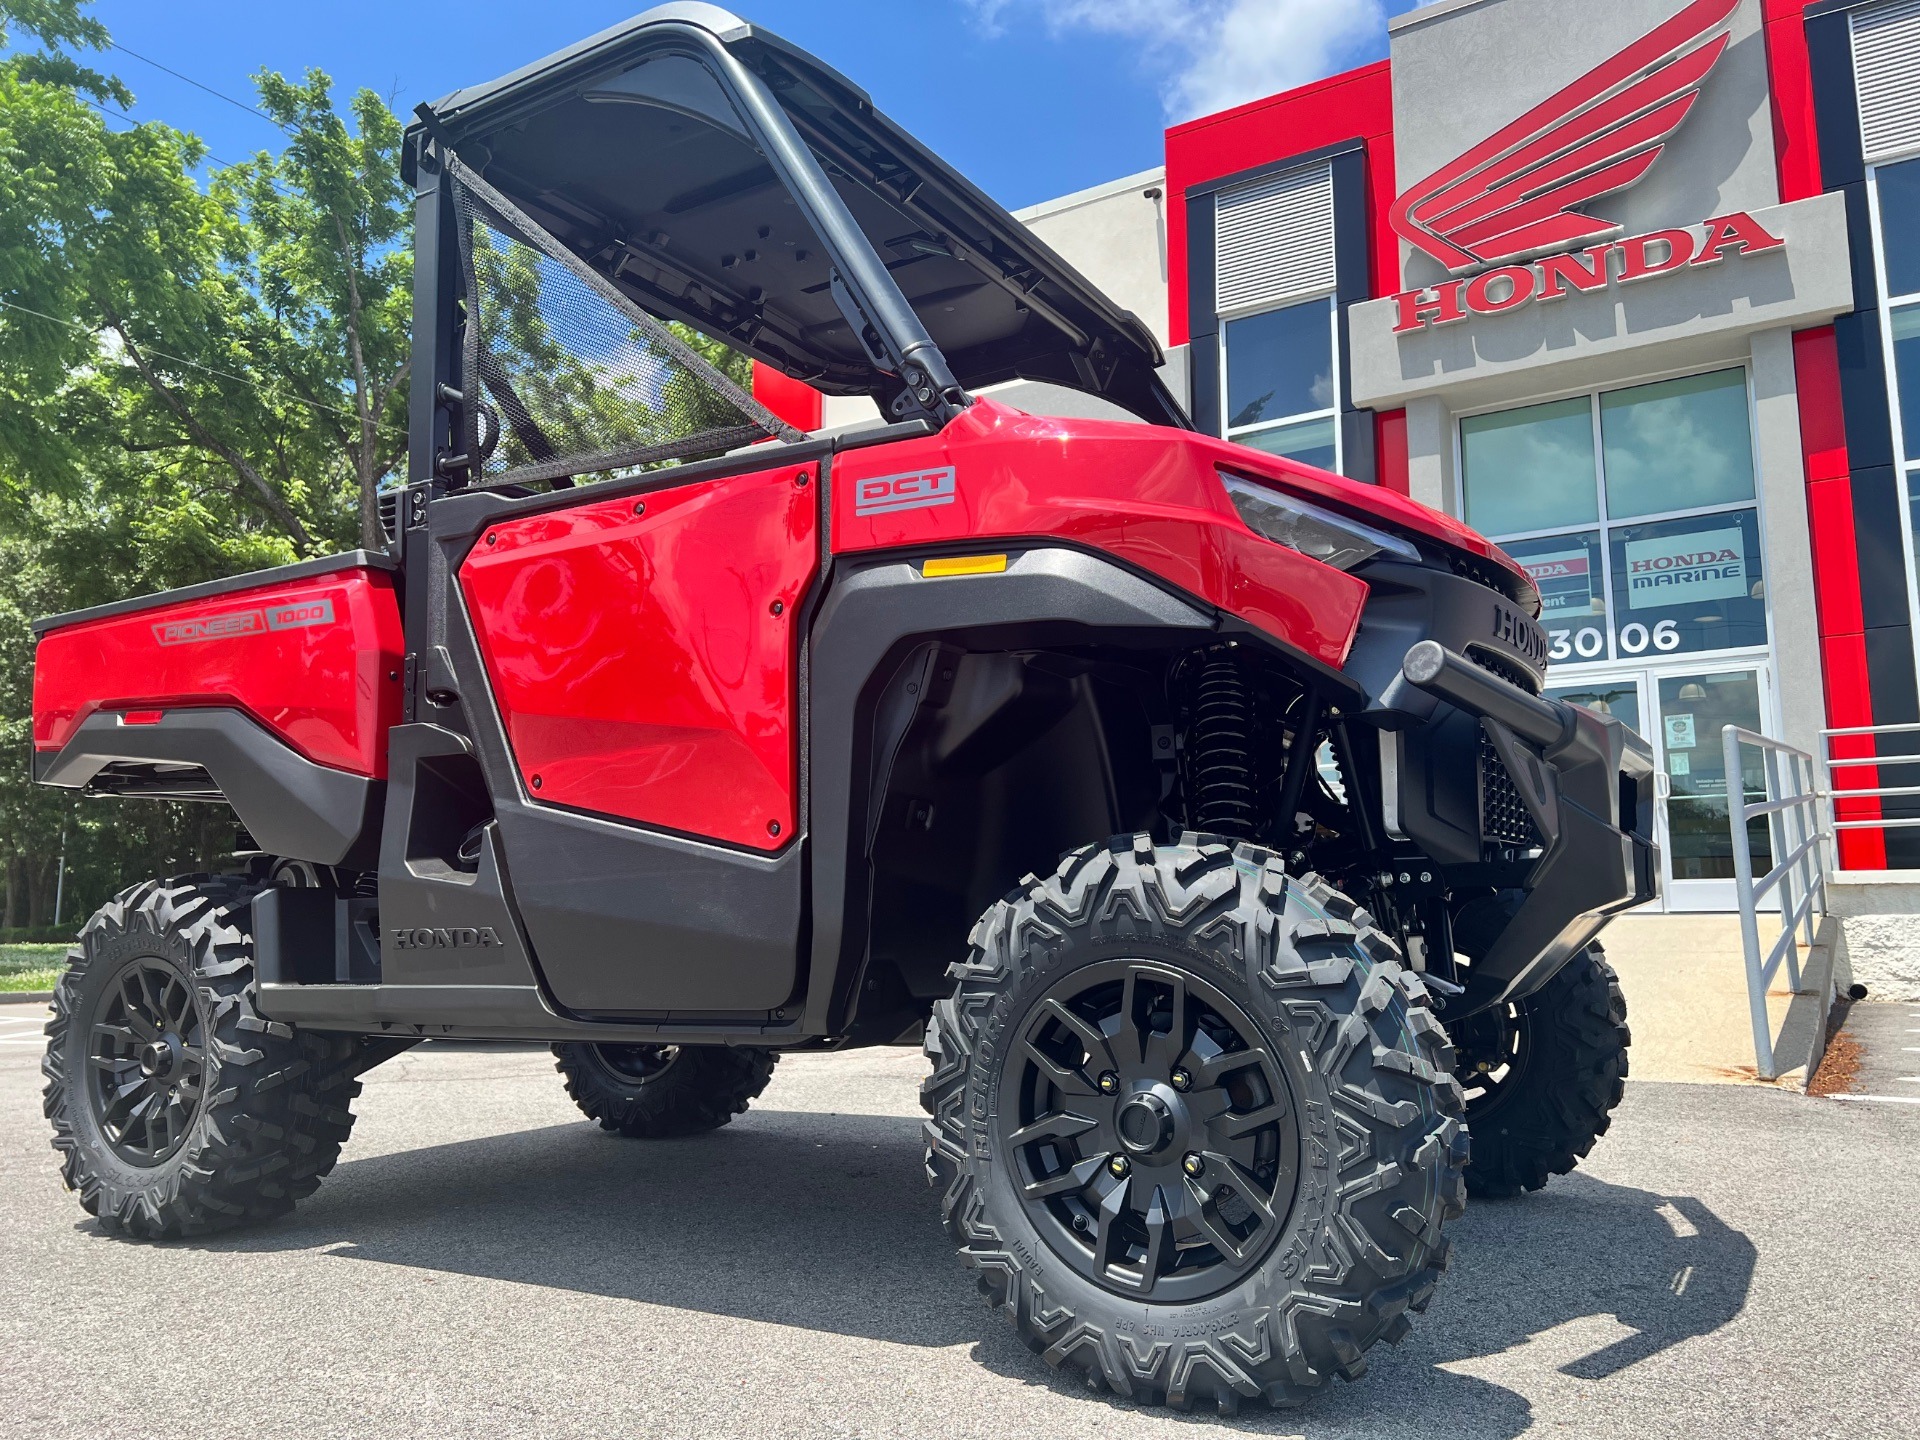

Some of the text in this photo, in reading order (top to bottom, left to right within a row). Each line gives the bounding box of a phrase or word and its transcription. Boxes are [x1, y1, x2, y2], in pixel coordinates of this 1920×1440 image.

[1392, 211, 1785, 333] HONDA
[863, 472, 948, 500] DCT
[1526, 564, 1570, 578] NDA
[1630, 549, 1740, 574] HONDA
[1633, 565, 1741, 590] MARINE
[165, 606, 324, 641] PIONEER 1000
[390, 926, 503, 950] HONDA
[971, 990, 1016, 1162] BIGHORN
[1279, 1099, 1329, 1280] MAXXIS
[1011, 1238, 1044, 1277] RADIAL
[1143, 1324, 1165, 1338] NHS
